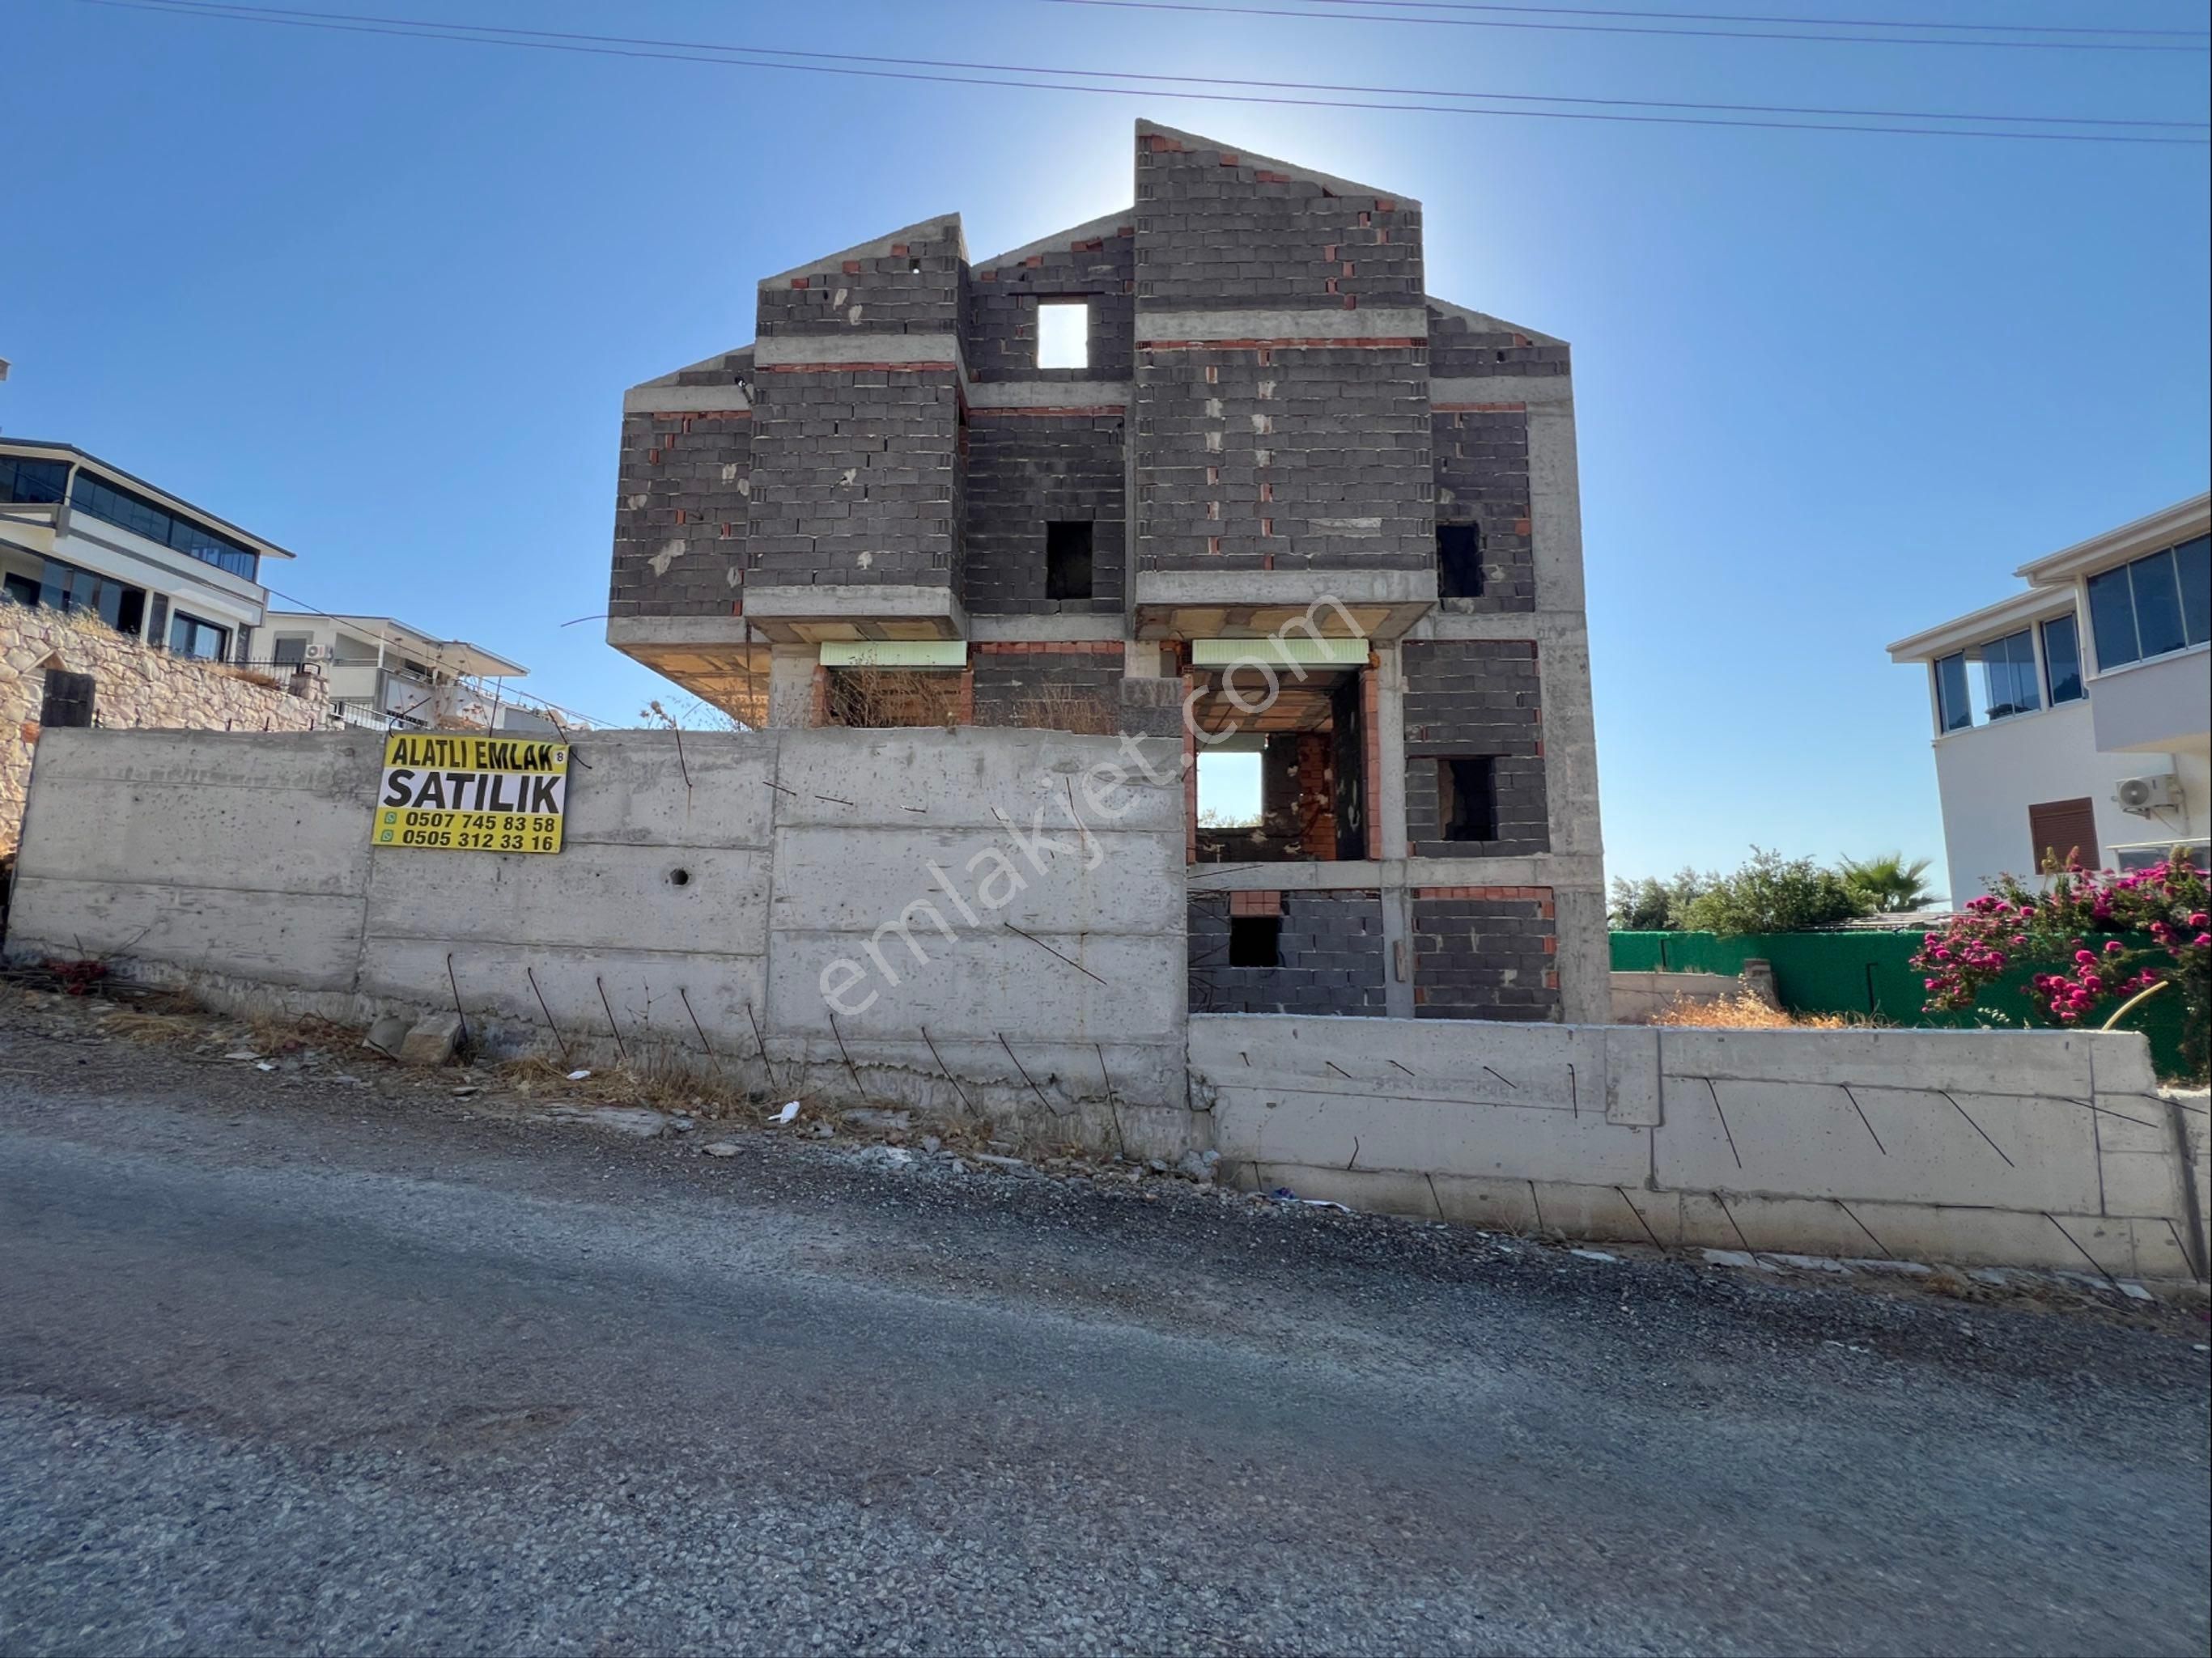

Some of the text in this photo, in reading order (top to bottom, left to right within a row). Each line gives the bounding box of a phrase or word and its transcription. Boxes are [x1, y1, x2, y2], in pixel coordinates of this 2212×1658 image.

[391, 738, 554, 771] ALATLI EMLAK
[383, 769, 561, 814] SATILIK
[405, 812, 555, 833] 0507 745 83 58
[403, 829, 553, 850] 0505 312 33 16
